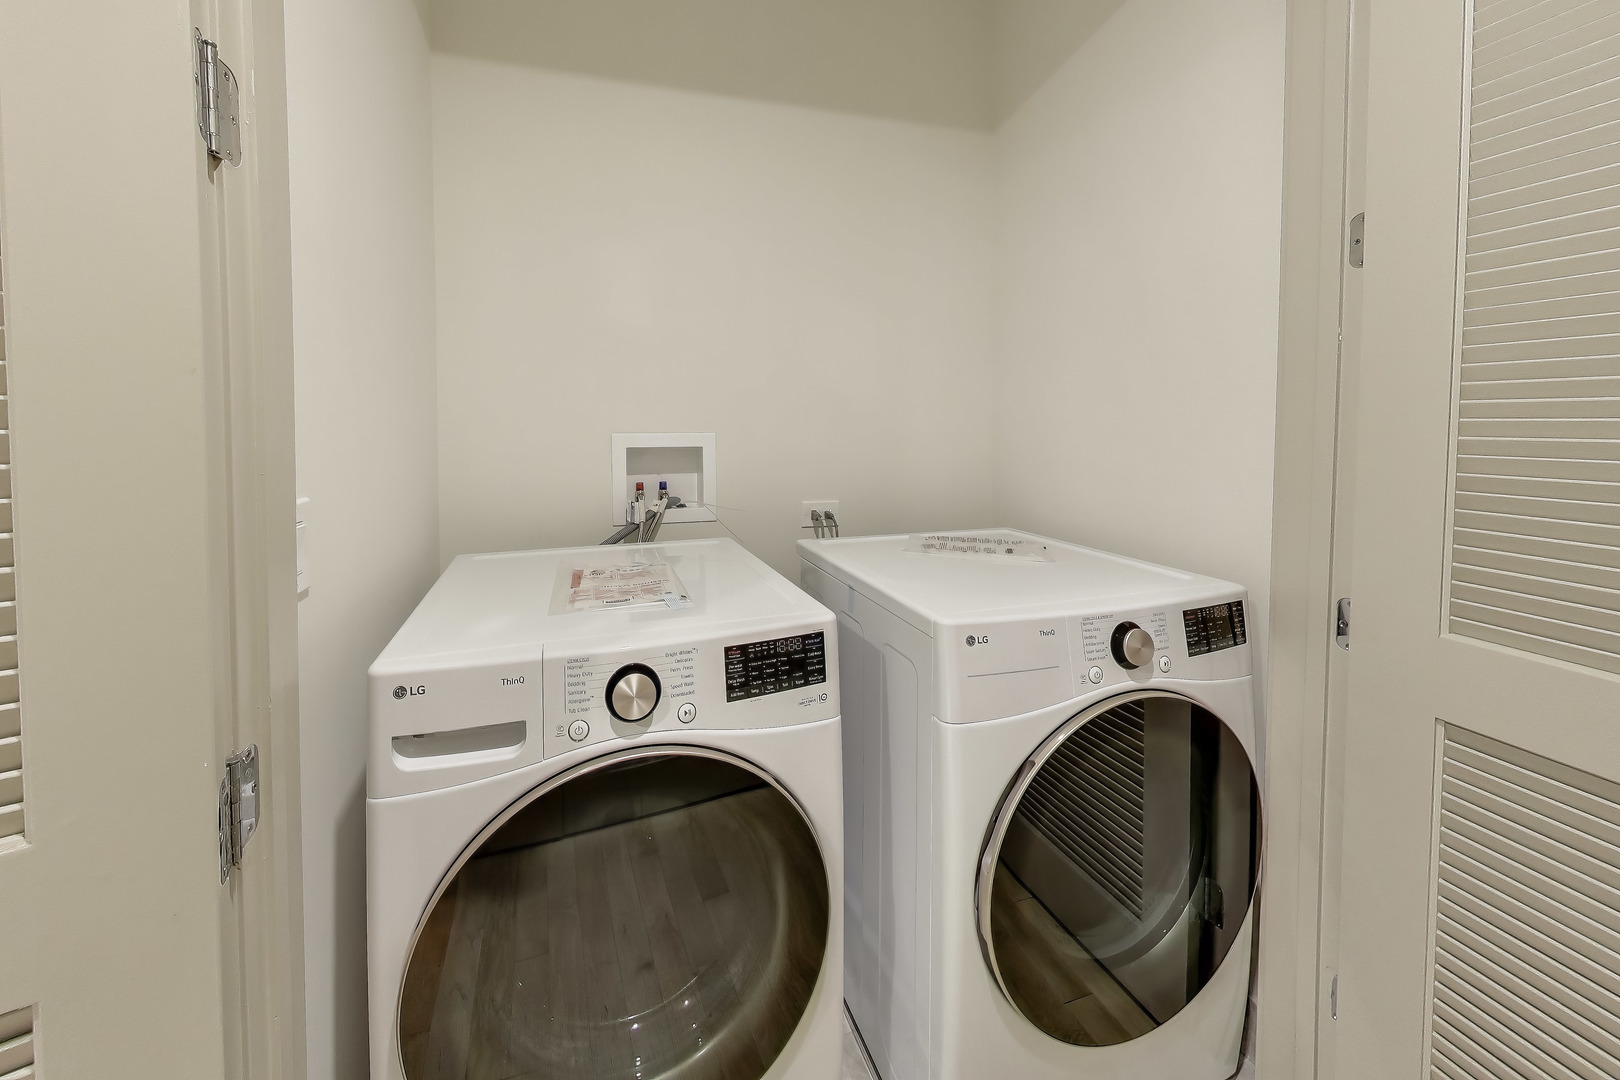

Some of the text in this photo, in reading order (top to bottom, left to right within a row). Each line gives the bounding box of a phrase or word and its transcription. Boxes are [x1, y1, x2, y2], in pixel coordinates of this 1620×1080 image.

[977, 636, 988, 644] LG
[501, 676, 525, 686] ThinQ
[410, 686, 426, 696] LG
